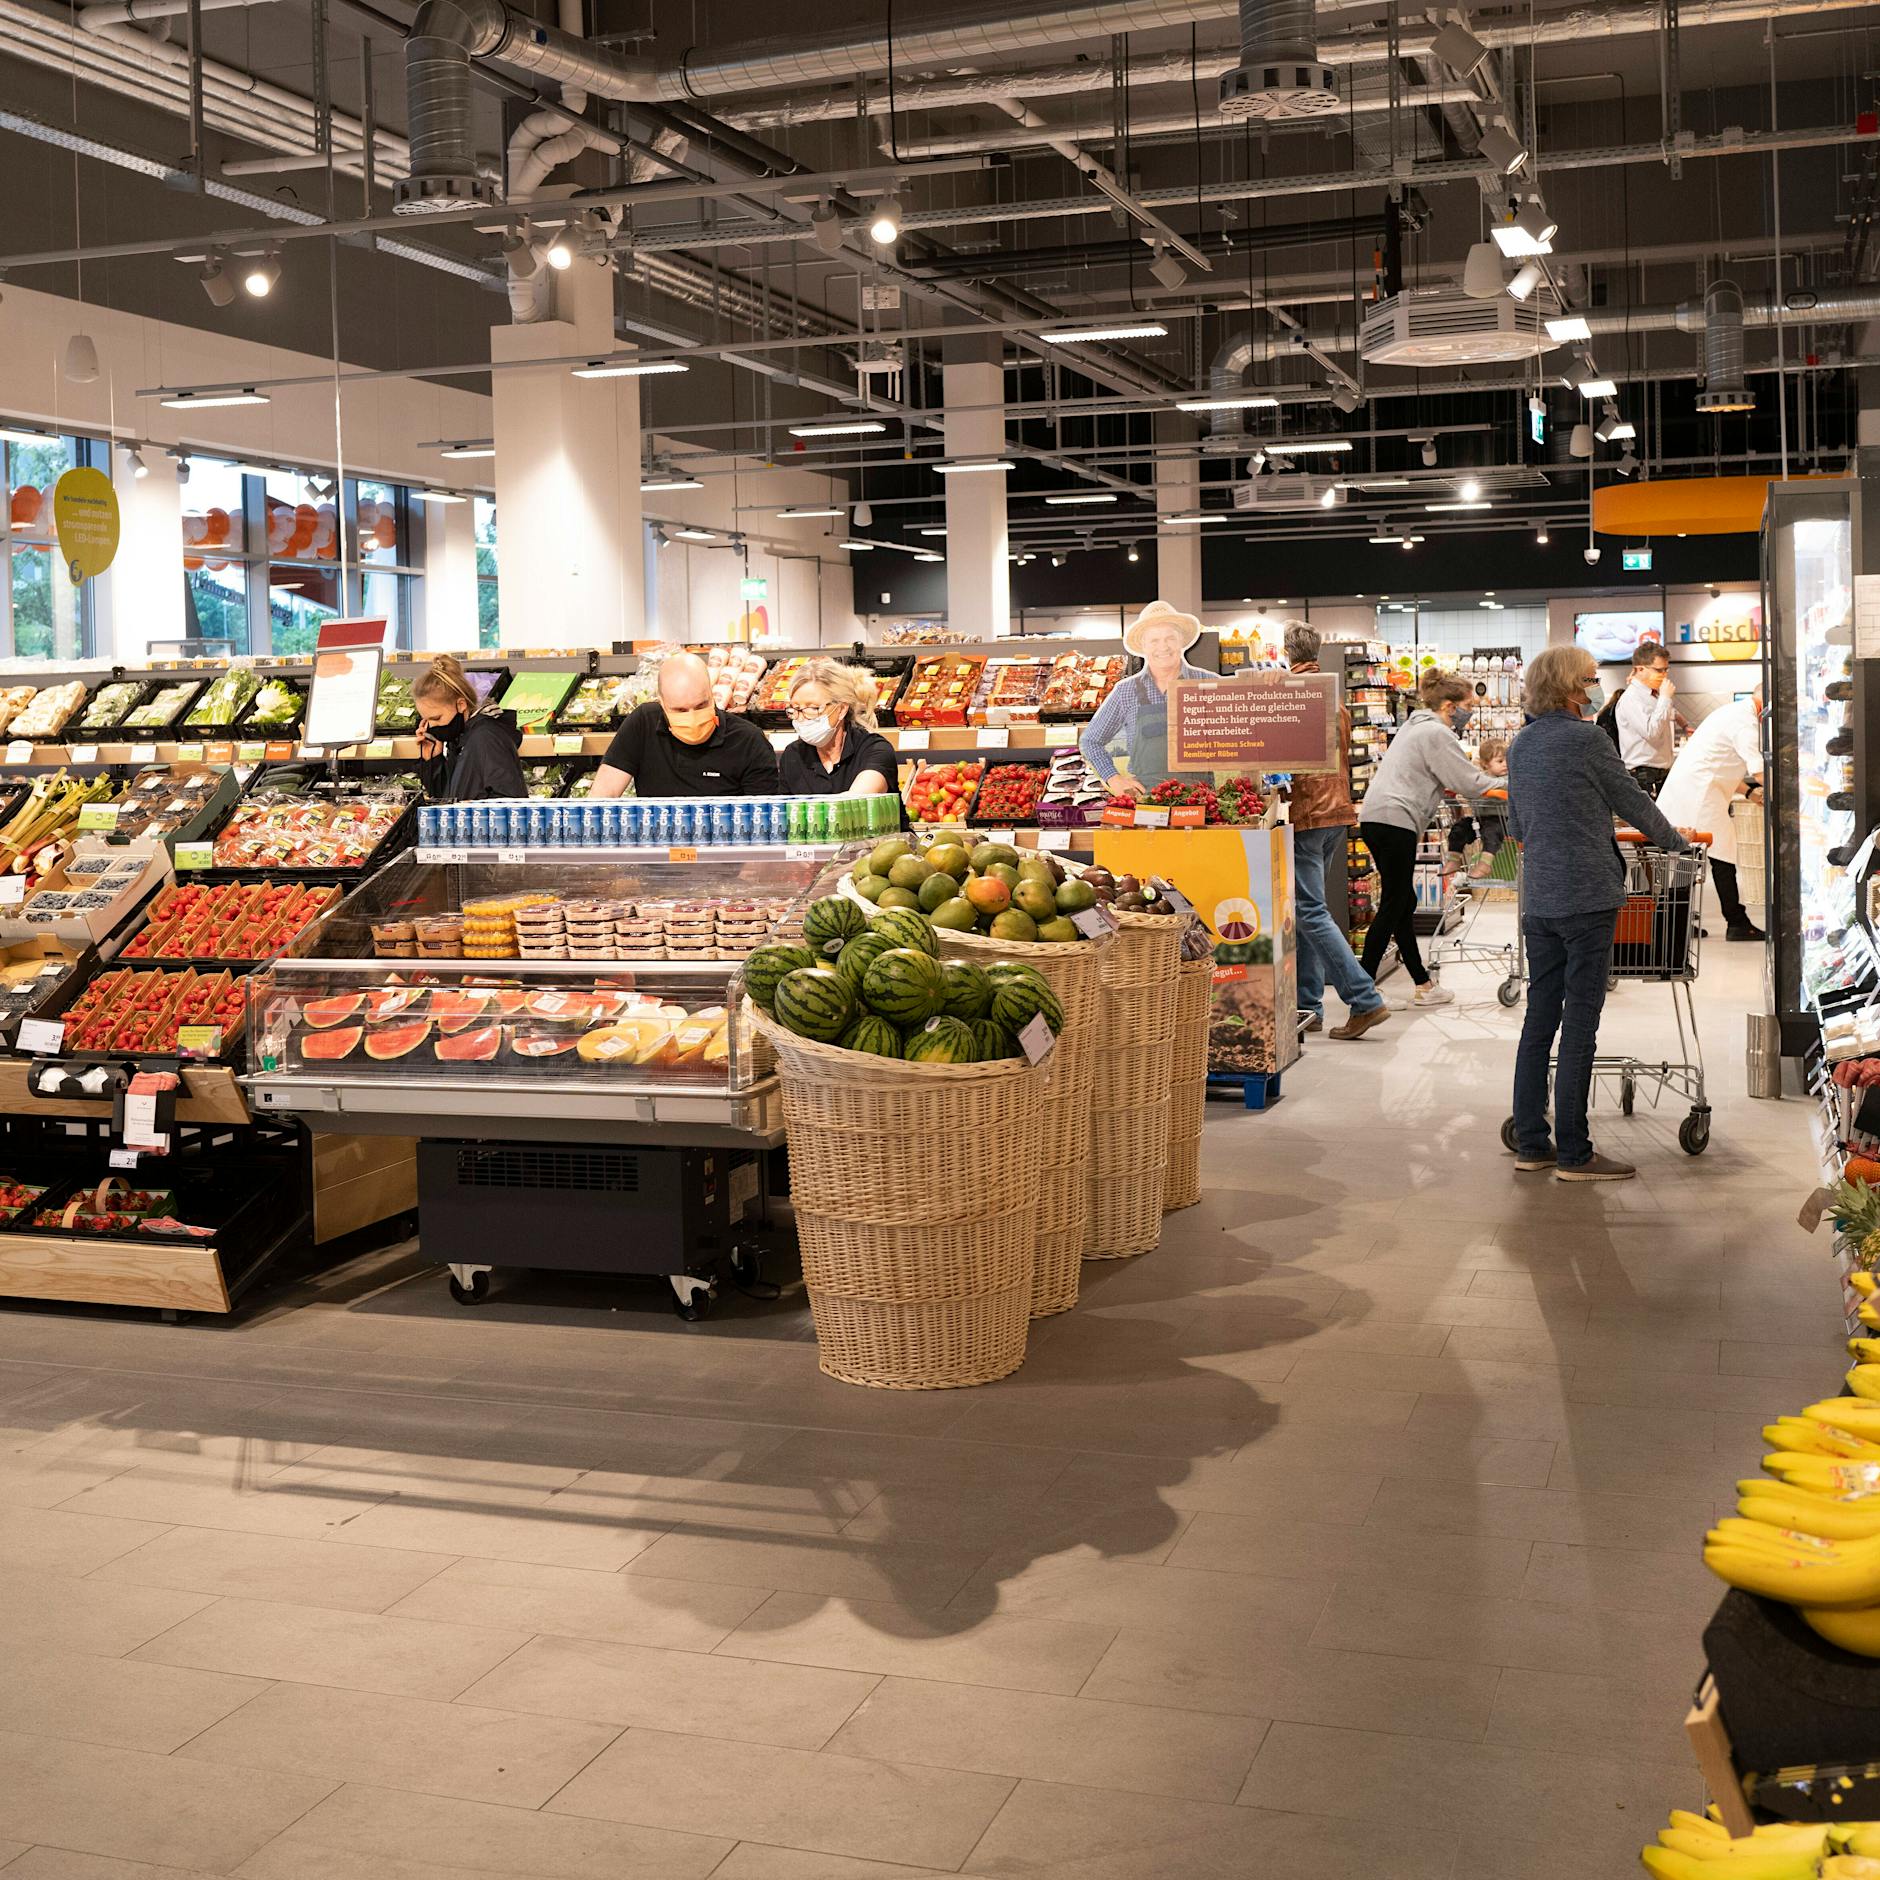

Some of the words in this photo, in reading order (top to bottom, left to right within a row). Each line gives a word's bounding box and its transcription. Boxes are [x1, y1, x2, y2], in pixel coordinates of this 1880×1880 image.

[1184, 693, 1198, 702] Bei
[1199, 692, 1245, 704] regionalen
[1247, 691, 1293, 701] Produkten
[1295, 690, 1322, 700] haben
[1184, 705, 1214, 714] tegut...
[1216, 704, 1232, 713] und
[1234, 704, 1248, 712] ich
[1250, 703, 1266, 712] den
[1268, 702, 1306, 713] gleichen
[1184, 716, 1229, 727] Anspruch:
[1230, 715, 1248, 724] hier
[1250, 715, 1300, 725] gewachsen,
[1184, 728, 1201, 736] hier
[1202, 726, 1253, 736] verarbeitet.
[1184, 741, 1212, 749] Landwirt
[1213, 740, 1238, 748] Thomas
[1240, 740, 1265, 748] Schwab
[1218, 749, 1238, 758] Rüben
[1106, 809, 1132, 818] Angebot
[1174, 810, 1199, 818] Angebot
